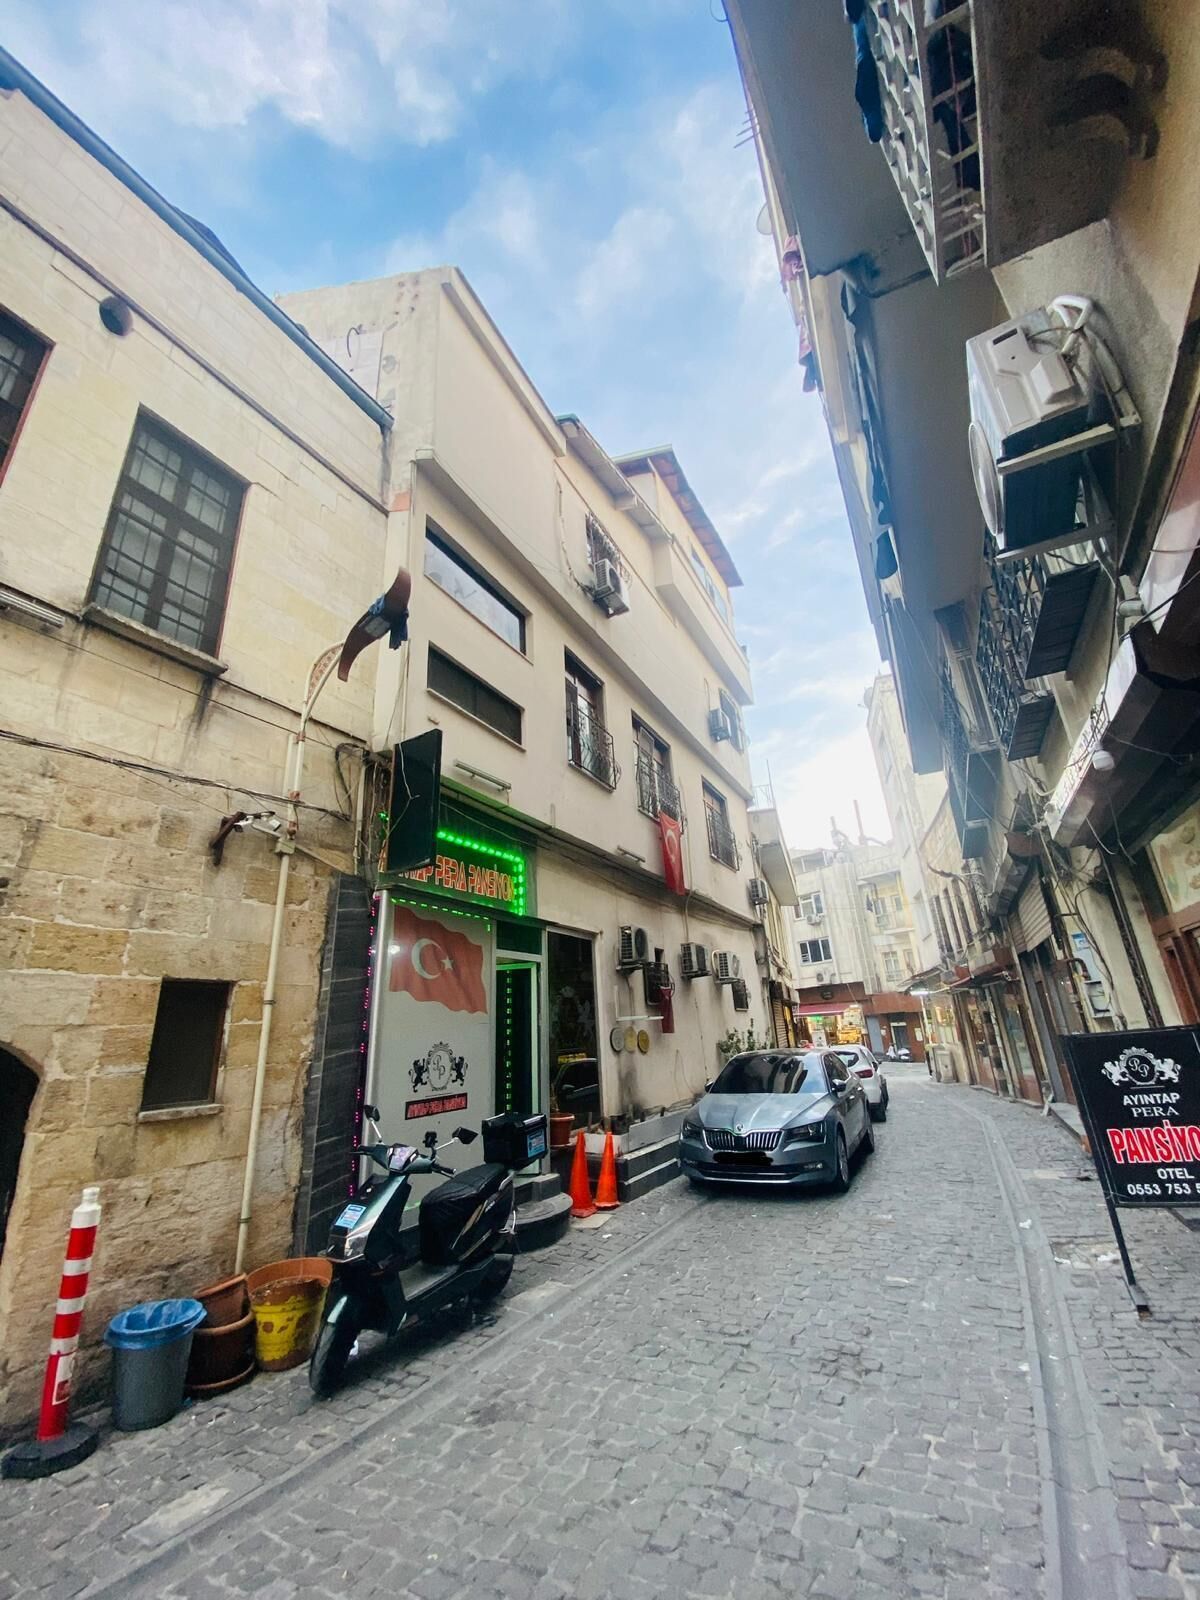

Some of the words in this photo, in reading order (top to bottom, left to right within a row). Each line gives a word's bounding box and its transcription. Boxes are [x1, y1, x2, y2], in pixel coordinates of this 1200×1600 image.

[435, 854, 467, 891] PERA
[1123, 1092, 1181, 1106] AYINTAP
[1131, 1106, 1180, 1117] PERA
[1156, 1167, 1195, 1180] OTEL
[1127, 1183, 1162, 1195] 0553
[1164, 1182, 1192, 1195] 753
